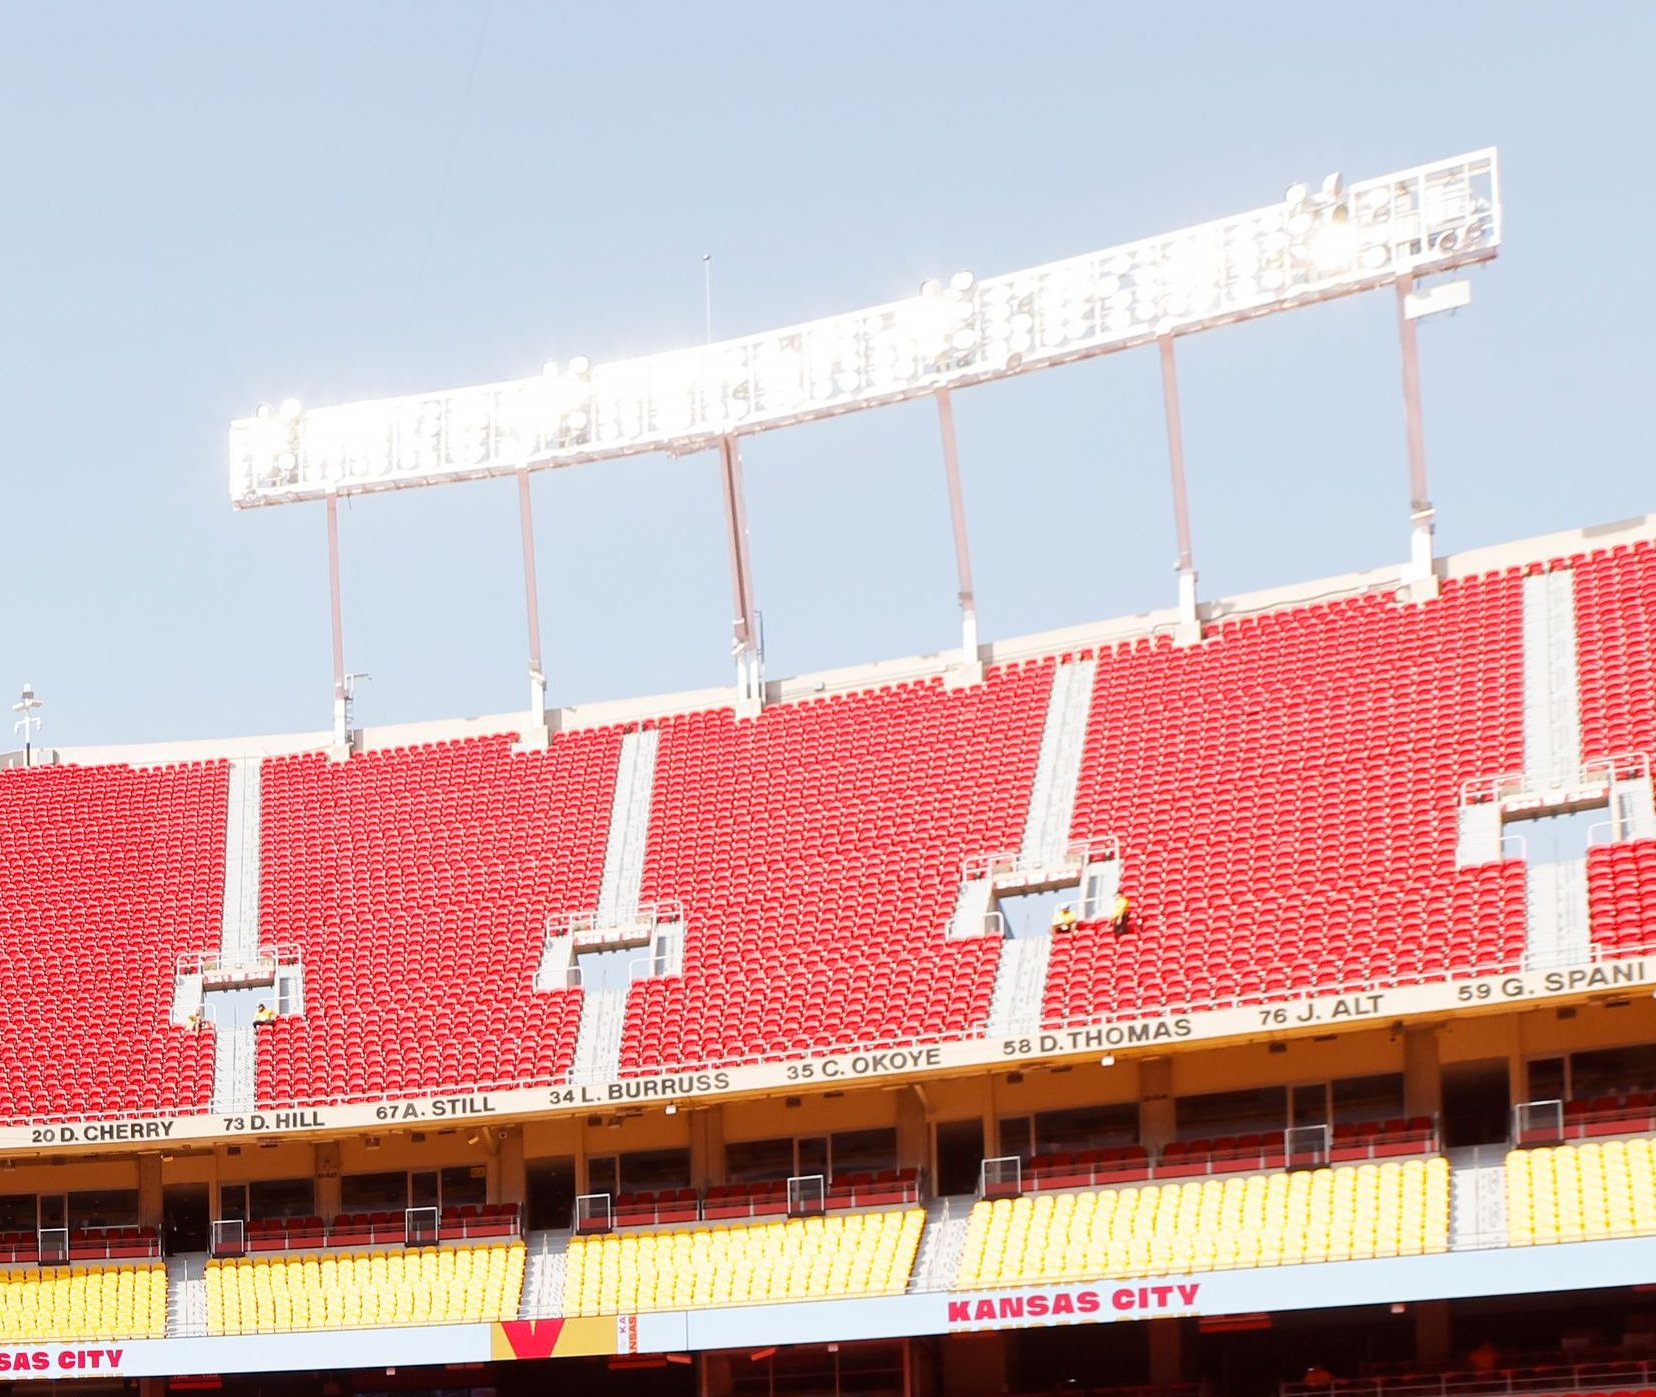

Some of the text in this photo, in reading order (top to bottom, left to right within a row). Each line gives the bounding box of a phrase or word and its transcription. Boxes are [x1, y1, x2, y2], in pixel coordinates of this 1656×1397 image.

[1457, 961, 1645, 1001] 59 G. SPANI
[1259, 994, 1385, 1026] 76 J. ALT
[1002, 1039, 1033, 1055] 58
[787, 1048, 943, 1080] 35 C. OKOYE
[548, 1073, 730, 1105] 34 L. BURRUSS
[223, 1109, 326, 1132] 73 D. HILL
[376, 1096, 497, 1120] 67 A. STILL
[32, 1121, 174, 1143] 20 D. CHERRY
[948, 1282, 1202, 1323] KANSAS CITY
[57, 1349, 124, 1369] CITY
